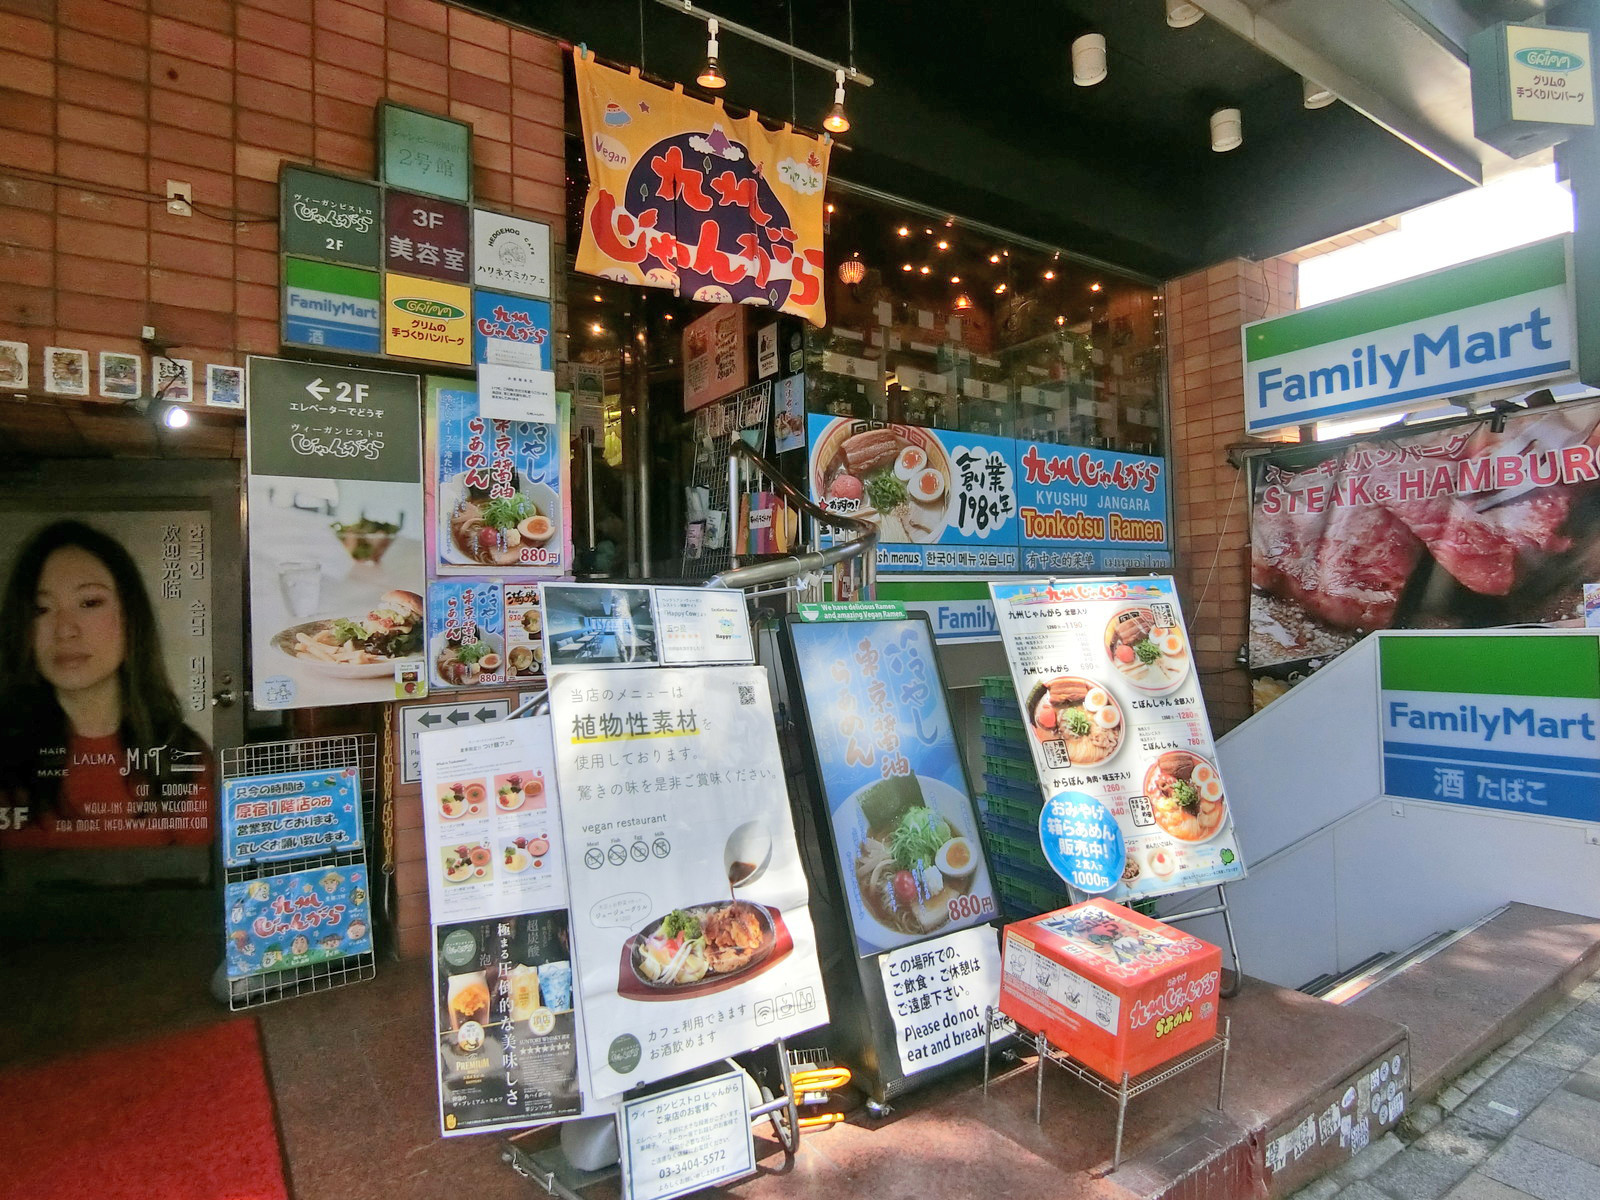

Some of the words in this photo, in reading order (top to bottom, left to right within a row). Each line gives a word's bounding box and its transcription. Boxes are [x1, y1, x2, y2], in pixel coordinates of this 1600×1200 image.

[1533, 75, 1566, 88] グリムの
[1516, 86, 1584, 102] 手づくりハンバーグ
[594, 135, 627, 165] Vegan
[399, 148, 455, 177] 2号館
[651, 145, 772, 226] 九州
[294, 194, 372, 214] ヴィーガンビストロ
[293, 201, 373, 233] じゃんがら
[412, 208, 444, 229] 3F
[325, 238, 344, 251] 2F
[488, 227, 521, 247] HEDGEHOG
[389, 234, 465, 272] 美容室
[477, 265, 545, 284] ハリネズミカフェ
[290, 294, 377, 320] FamilyMart
[492, 304, 534, 326] 九州
[308, 329, 325, 346] 酒
[391, 327, 465, 346] 手づくりハンバーグ
[411, 319, 446, 333] グリムの
[477, 318, 548, 344] じゃんがら
[1257, 306, 1553, 409] FamilyMart
[336, 380, 369, 405] 2F
[290, 402, 384, 419] エレベーターでどうぞ
[291, 423, 384, 438] ヴィーガンビストロ
[290, 433, 385, 460] じゃんがら
[465, 417, 489, 489] らあめん
[1021, 445, 1160, 494] 九州じゃんがら
[1036, 490, 1087, 507] KYUSHU
[1097, 495, 1151, 511] JANGARA
[1020, 507, 1104, 540] Tonkotsu
[1109, 513, 1164, 543] Ramen
[162, 524, 182, 599] 欢迎光临
[519, 547, 559, 565] 880円
[926, 551, 956, 566] 한국어
[958, 551, 977, 566] 메뉴
[979, 552, 1015, 566] 있습니다
[1026, 551, 1095, 570] 有中文的菜单
[445, 597, 460, 641] らあめん
[476, 584, 498, 633] 冷やし
[837, 611, 863, 620] amazing
[863, 611, 882, 619] Vegan
[848, 603, 875, 611] delicious
[1008, 608, 1062, 620] 九州じゃんがら
[478, 673, 505, 684] 880円
[1023, 664, 1070, 675] 九州じゃんがら
[571, 686, 684, 703] 当店のメニューは
[884, 628, 939, 746] 冷やし
[831, 660, 875, 769] らあめん
[1131, 698, 1173, 709] こぼんしゃん
[572, 708, 712, 741] 植物性素材を
[1389, 701, 1596, 742] FamilyMart
[1142, 741, 1179, 751] こぼんしゃん
[73, 752, 116, 765] LALMA
[574, 746, 699, 771] 使用しております。
[37, 769, 70, 777] MAKE
[577, 767, 778, 801] 驚きの味を是非ご賞味ください。
[1053, 775, 1085, 788] からぼん
[136, 784, 149, 796] CUT
[235, 780, 305, 798] 只今の時間は
[1433, 767, 1465, 800] 酒
[1476, 773, 1548, 806] たばこ
[127, 801, 158, 813] ALWAYS
[234, 795, 332, 820] 原宿1階店のみ
[1051, 799, 1106, 821] おみやげ
[56, 820, 73, 832] FOR
[76, 819, 100, 831] MORE
[236, 814, 339, 838] 営業致しております。
[582, 821, 613, 834] vegan
[616, 813, 668, 829] restaurant
[1047, 817, 1115, 842] 箱らあめん
[236, 830, 350, 857] 宜しくお願い致します。
[1059, 838, 1109, 859] 販売中!
[1071, 870, 1109, 887] 1000円
[271, 892, 324, 916] 九州
[948, 893, 994, 922] 880円
[253, 903, 346, 938] じゃんがら
[526, 918, 541, 958] 超炭酸
[480, 954, 492, 967] 泡
[889, 946, 961, 977] この場所での、
[893, 958, 981, 997] ご飲食・ご休憩は
[1166, 972, 1187, 987] おみやげ
[897, 985, 970, 1017] ご遠慮下さい。
[1130, 970, 1219, 1030] 九州じゃんがら
[496, 922, 519, 1106] 極まる圧倒的な美味しさ
[648, 1003, 747, 1043] カフェ利用できます
[905, 1020, 940, 1042] Please
[942, 1012, 958, 1028] do
[960, 1004, 980, 1023] not
[1155, 1006, 1194, 1039] らあめん
[650, 1028, 718, 1060] お酒飲めます
[907, 1044, 929, 1062] eat
[931, 1034, 951, 1055] and
[952, 1022, 986, 1046] break
[631, 1093, 701, 1121] ヴィーガンビストロ
[704, 1083, 739, 1100] じゃんがら
[656, 1101, 718, 1125] ご来店のお客様へ
[659, 1149, 726, 1179] 03-3404-5572
